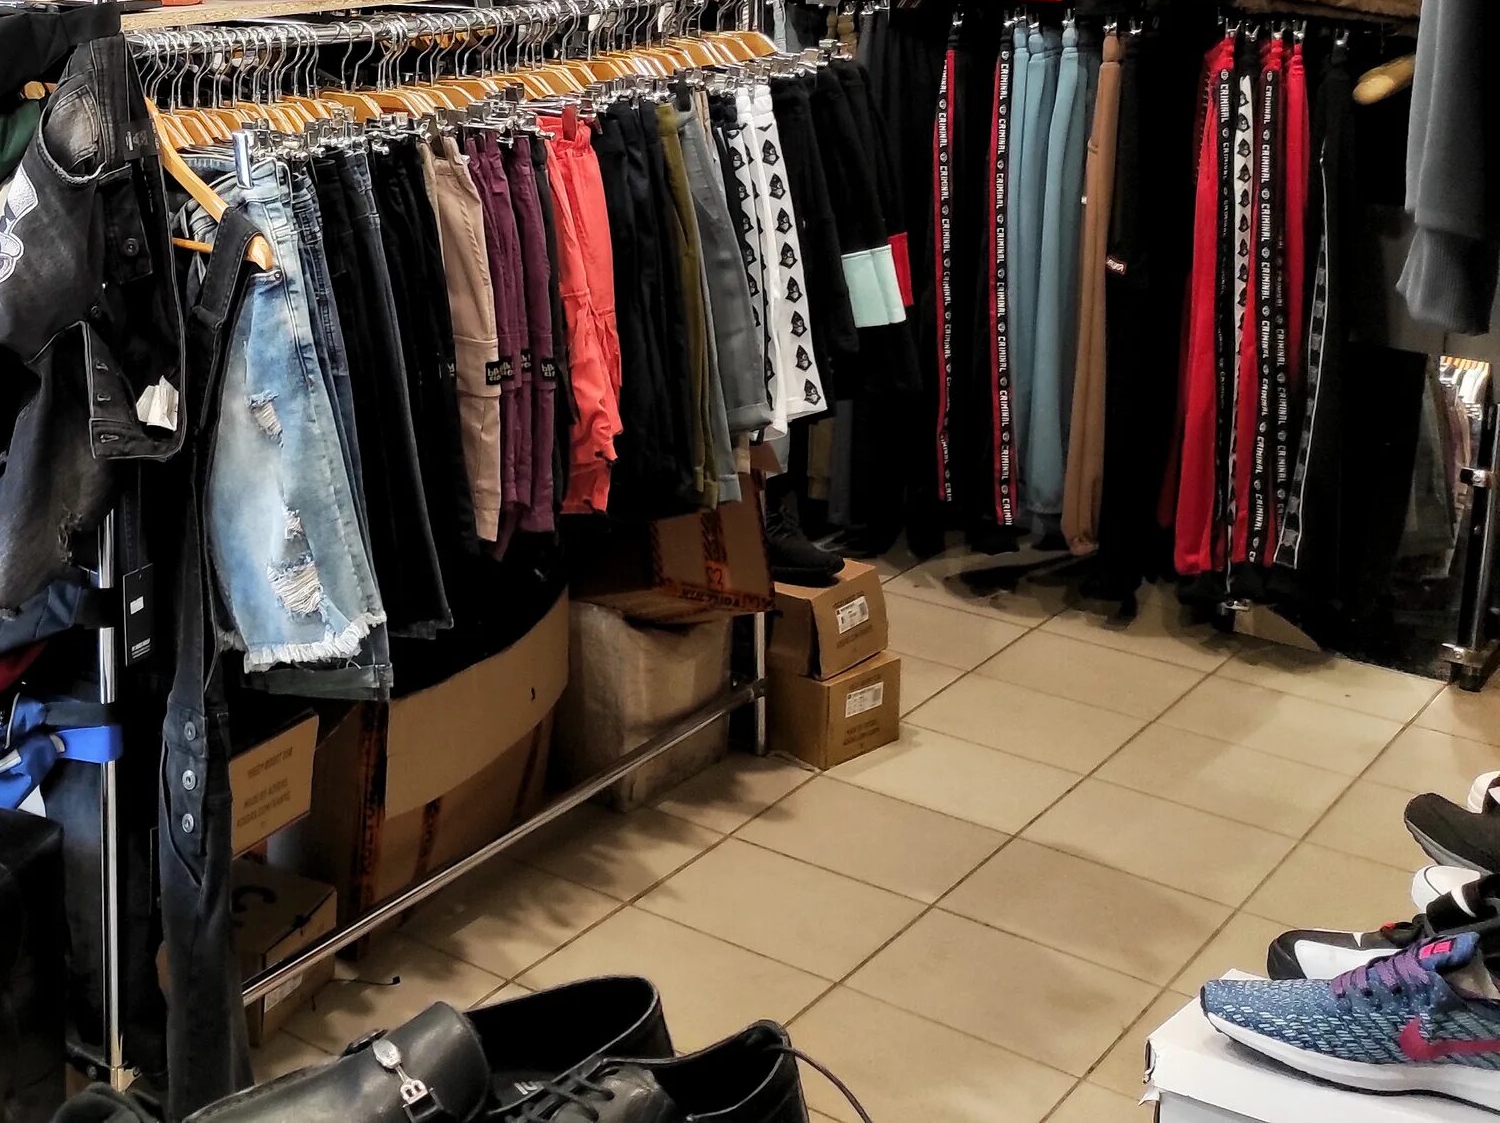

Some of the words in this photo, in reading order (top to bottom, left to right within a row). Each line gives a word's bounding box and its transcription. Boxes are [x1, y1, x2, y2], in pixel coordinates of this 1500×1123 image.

[999, 63, 1010, 100] CRIMINAL
[1219, 84, 1229, 123] CRIMINAL
[1263, 85, 1273, 125] CRIMINAL
[938, 112, 948, 148] CRIMINAL
[997, 118, 1007, 155] CRIMINAL
[1261, 144, 1270, 184] CRIMINAL
[996, 173, 1005, 209] CRIMINAL
[1261, 203, 1271, 242] CRIMINAL
[996, 227, 1005, 264] CRIMINAL
[1261, 262, 1271, 300] CRIMINAL
[999, 389, 1010, 427] CRIMINAL
[1255, 436, 1265, 474] CRIMINAL
[1277, 445, 1287, 484] CRIMINAL
